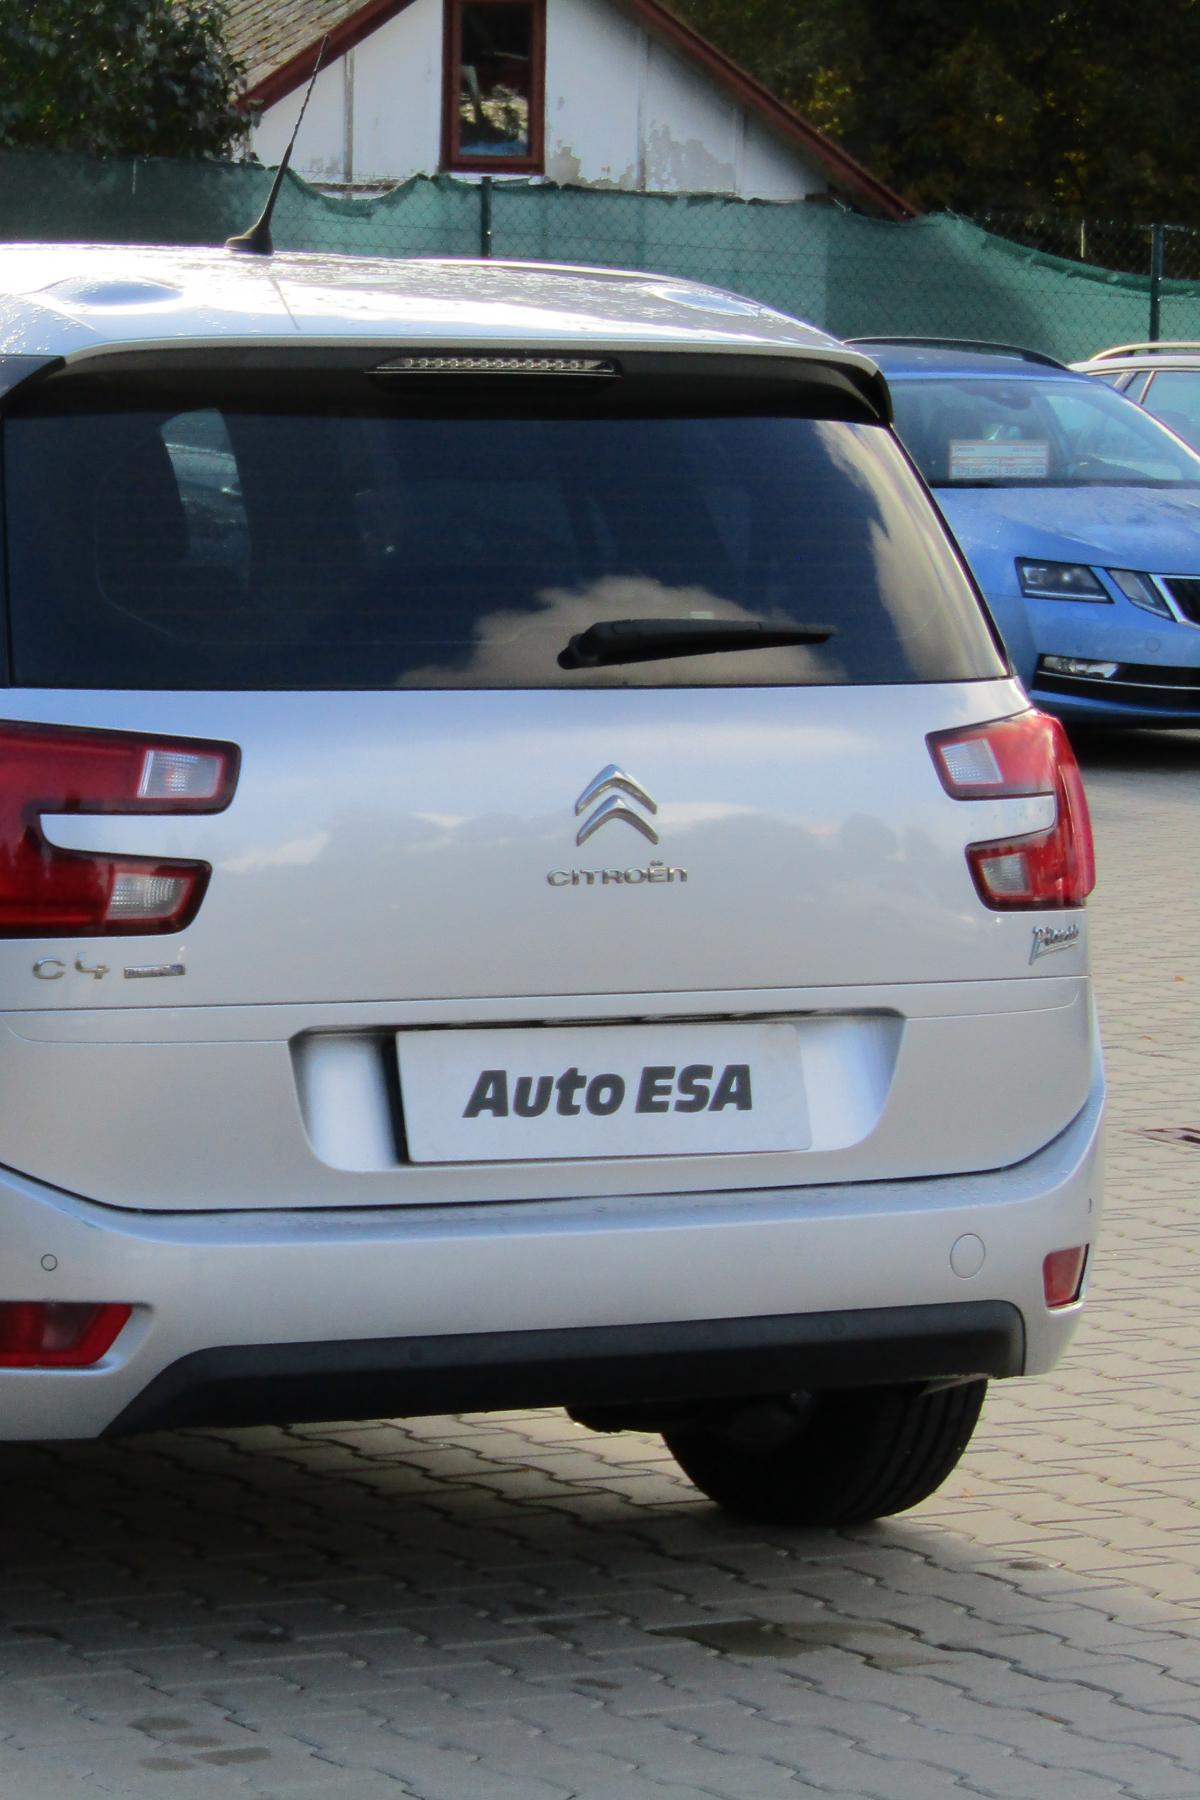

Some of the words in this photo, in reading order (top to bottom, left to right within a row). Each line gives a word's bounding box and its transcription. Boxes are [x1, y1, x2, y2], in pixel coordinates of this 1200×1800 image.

[32, 951, 110, 980] C4
[461, 1066, 626, 1118] Auto
[634, 1063, 753, 1114] ESA
